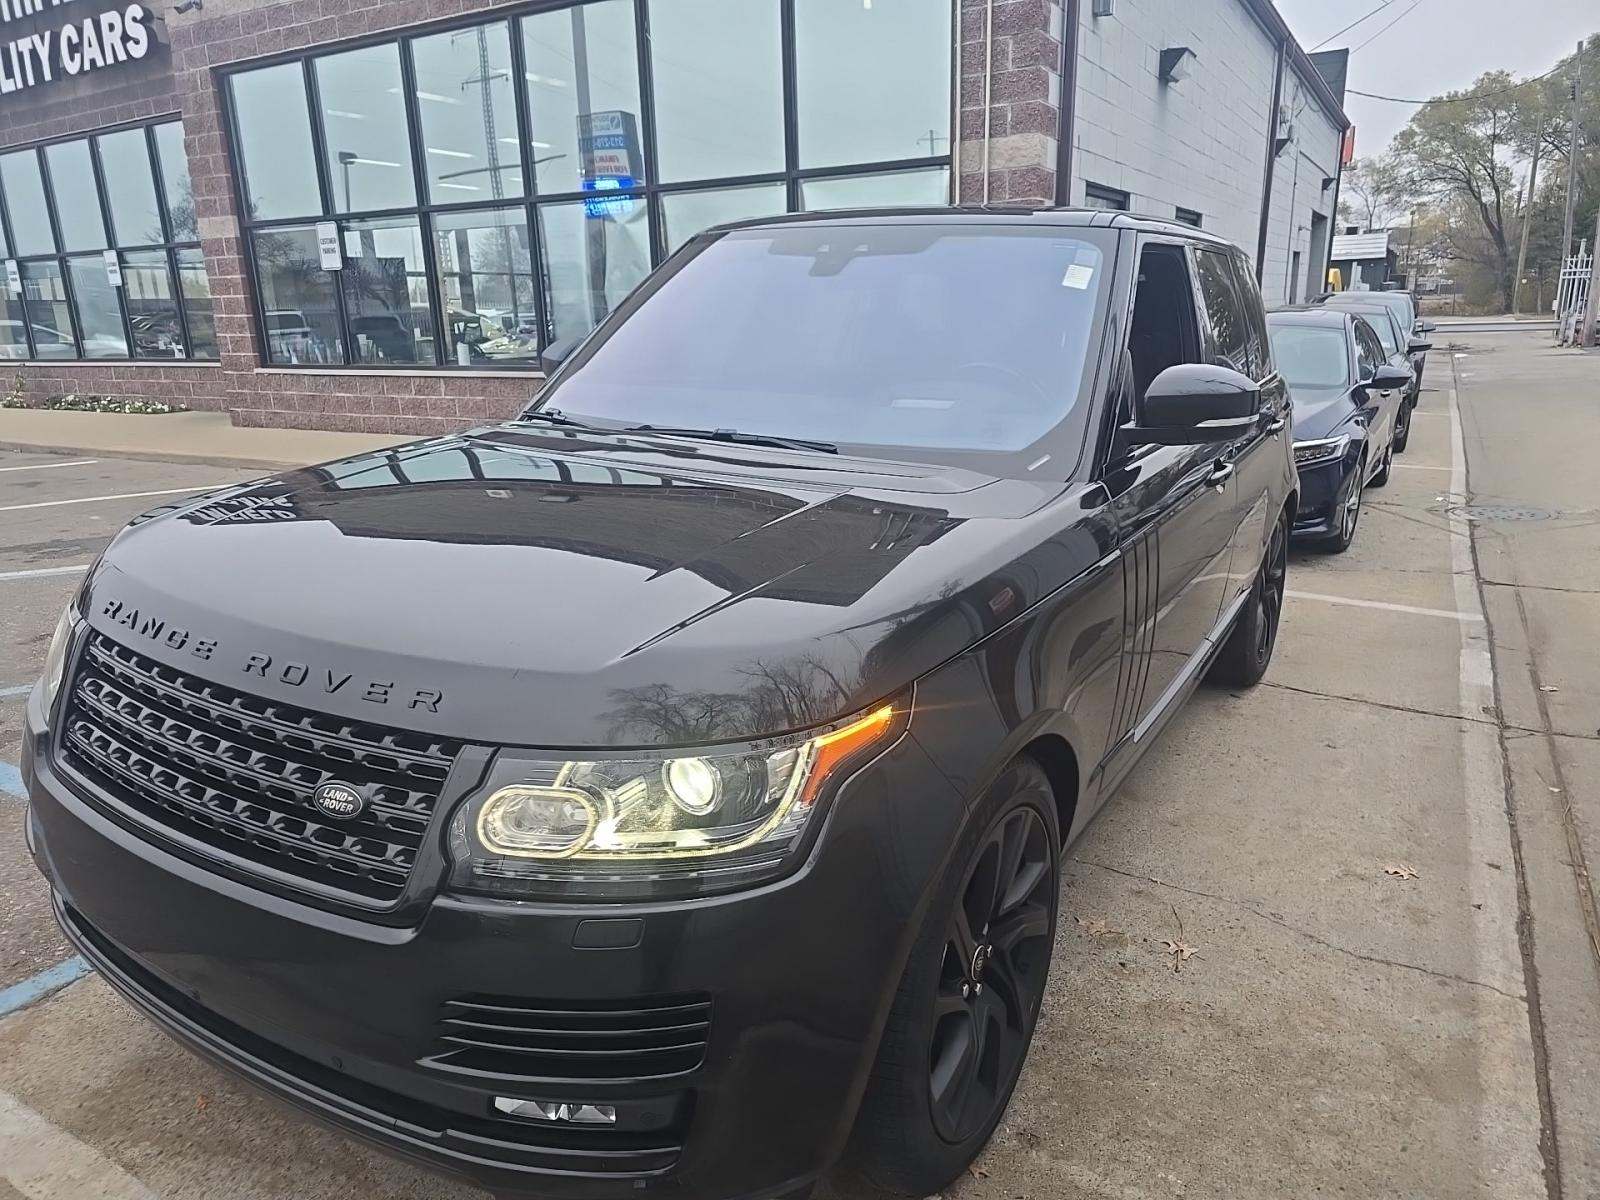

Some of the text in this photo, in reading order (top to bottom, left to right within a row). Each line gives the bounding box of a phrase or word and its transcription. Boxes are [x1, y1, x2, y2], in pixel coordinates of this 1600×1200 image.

[60, 4, 148, 75] CARS
[102, 600, 443, 713] RANGE ROVER
[322, 787, 348, 801] LAND
[322, 798, 354, 813] ROVER
